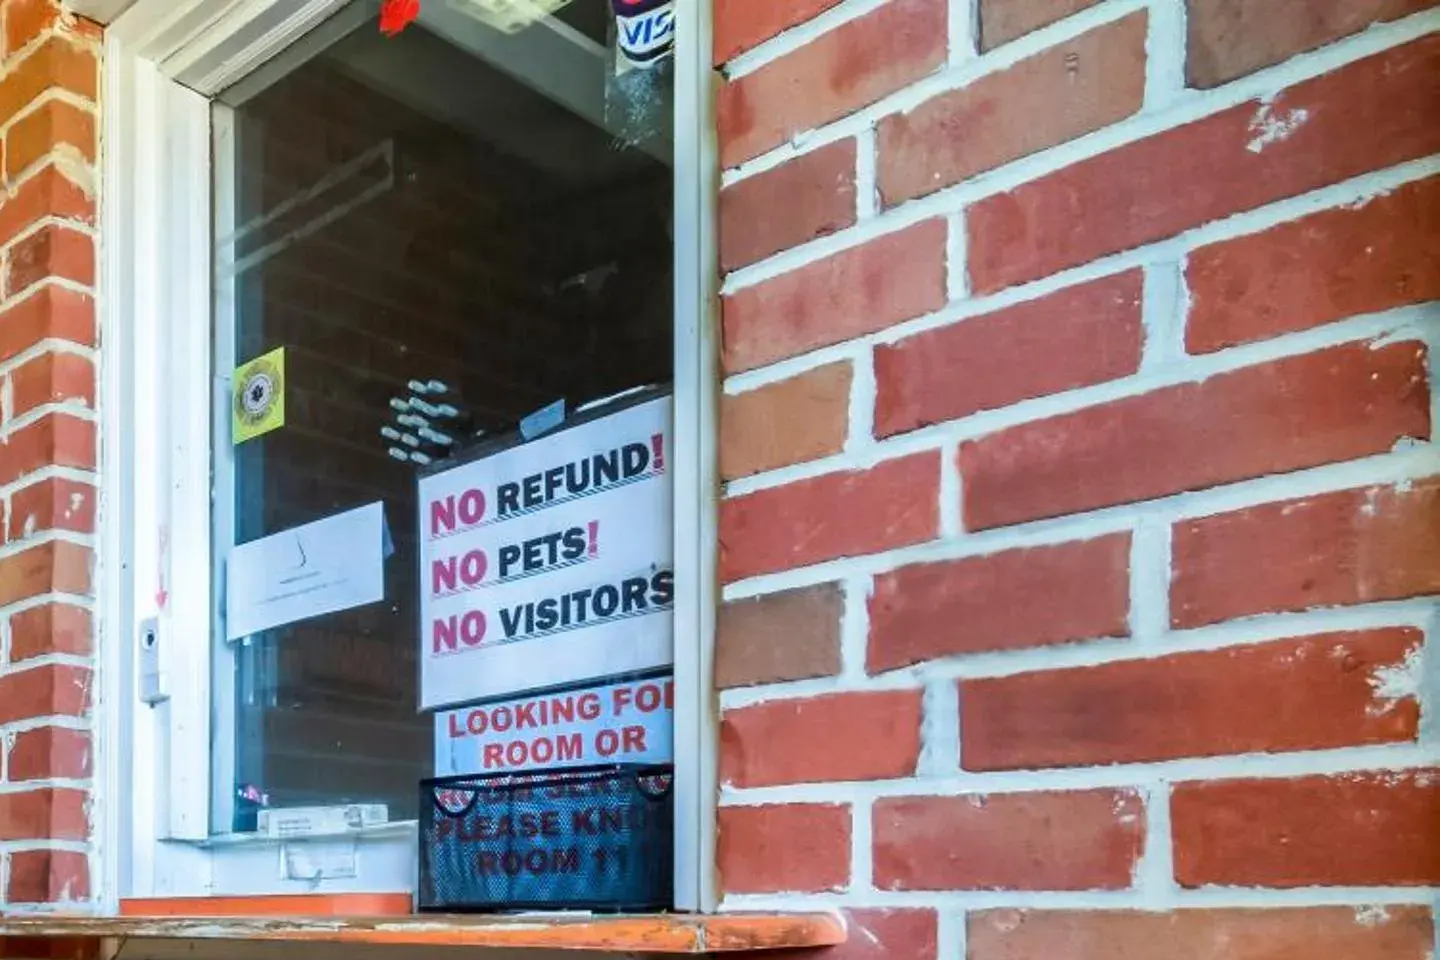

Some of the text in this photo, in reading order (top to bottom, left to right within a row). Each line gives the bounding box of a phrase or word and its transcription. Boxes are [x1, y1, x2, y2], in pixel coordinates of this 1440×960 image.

[624, 10, 675, 45] VIS
[430, 433, 664, 534] NO REFUND!
[432, 520, 599, 594] NO PETS!
[433, 610, 486, 653] NO
[448, 692, 601, 738] LOOKING
[483, 725, 646, 768] ROOM OR
[437, 811, 561, 842] PLEASE
[478, 847, 580, 876] ROOM
